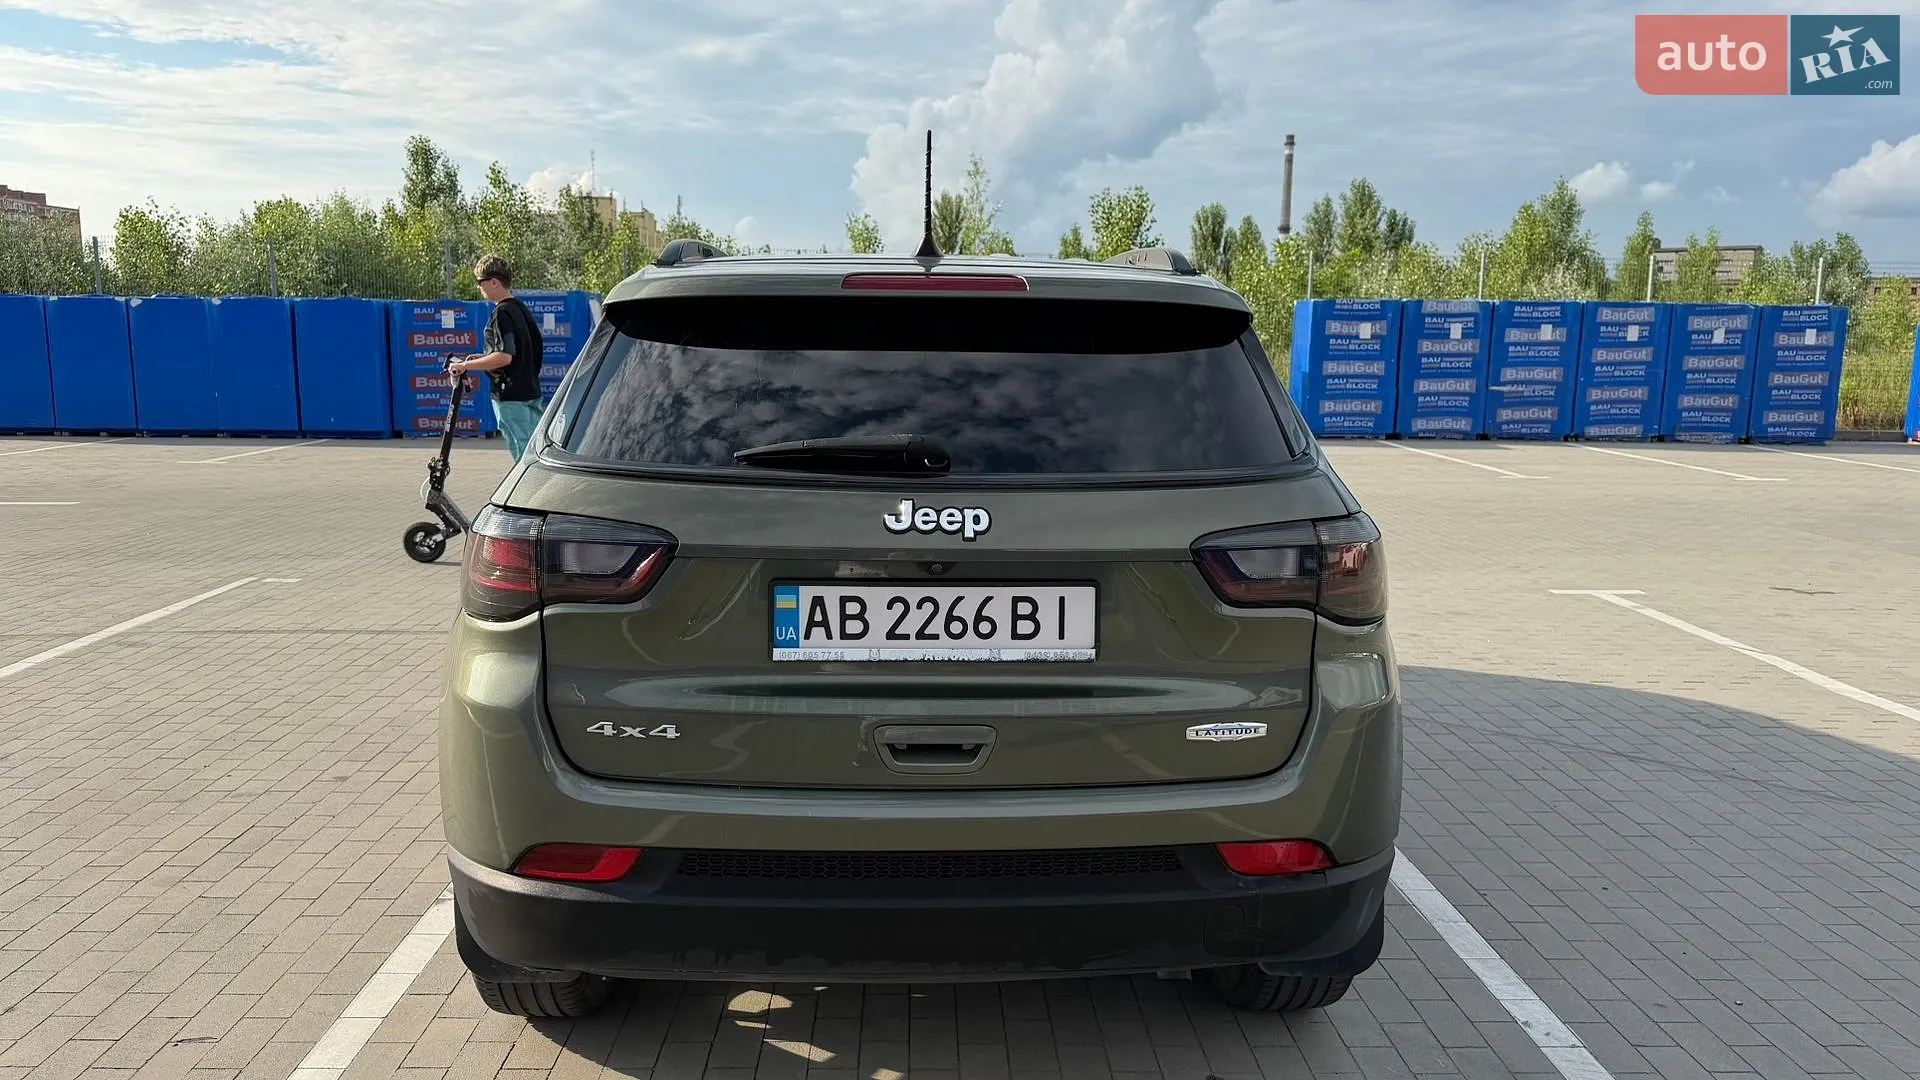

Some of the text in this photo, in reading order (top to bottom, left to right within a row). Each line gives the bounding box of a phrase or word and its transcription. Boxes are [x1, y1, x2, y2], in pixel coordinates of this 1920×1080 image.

[435, 311, 468, 319] BCK
[1601, 310, 1649, 320] BauGut
[1693, 317, 1742, 328] BauGut
[413, 333, 471, 345] BauGut
[1422, 341, 1473, 352] BauGut
[1597, 350, 1647, 361] BauGut
[1328, 361, 1379, 373] BauGut
[1688, 357, 1738, 368] BauGut
[1506, 368, 1558, 379] BauGut
[1773, 374, 1823, 384] BauGut
[1419, 380, 1471, 391] BauGut
[1591, 388, 1643, 400] BauGut
[1324, 401, 1376, 412] BauGut
[1683, 395, 1733, 407] BauGut
[1502, 408, 1553, 419] BauGut
[1768, 411, 1819, 422] BauGut
[1417, 418, 1466, 429] BauGut
[883, 499, 991, 540] Jeep
[803, 595, 870, 641] AB
[885, 595, 998, 641] 2266
[776, 626, 797, 641] UA
[586, 721, 680, 739] 4x4
